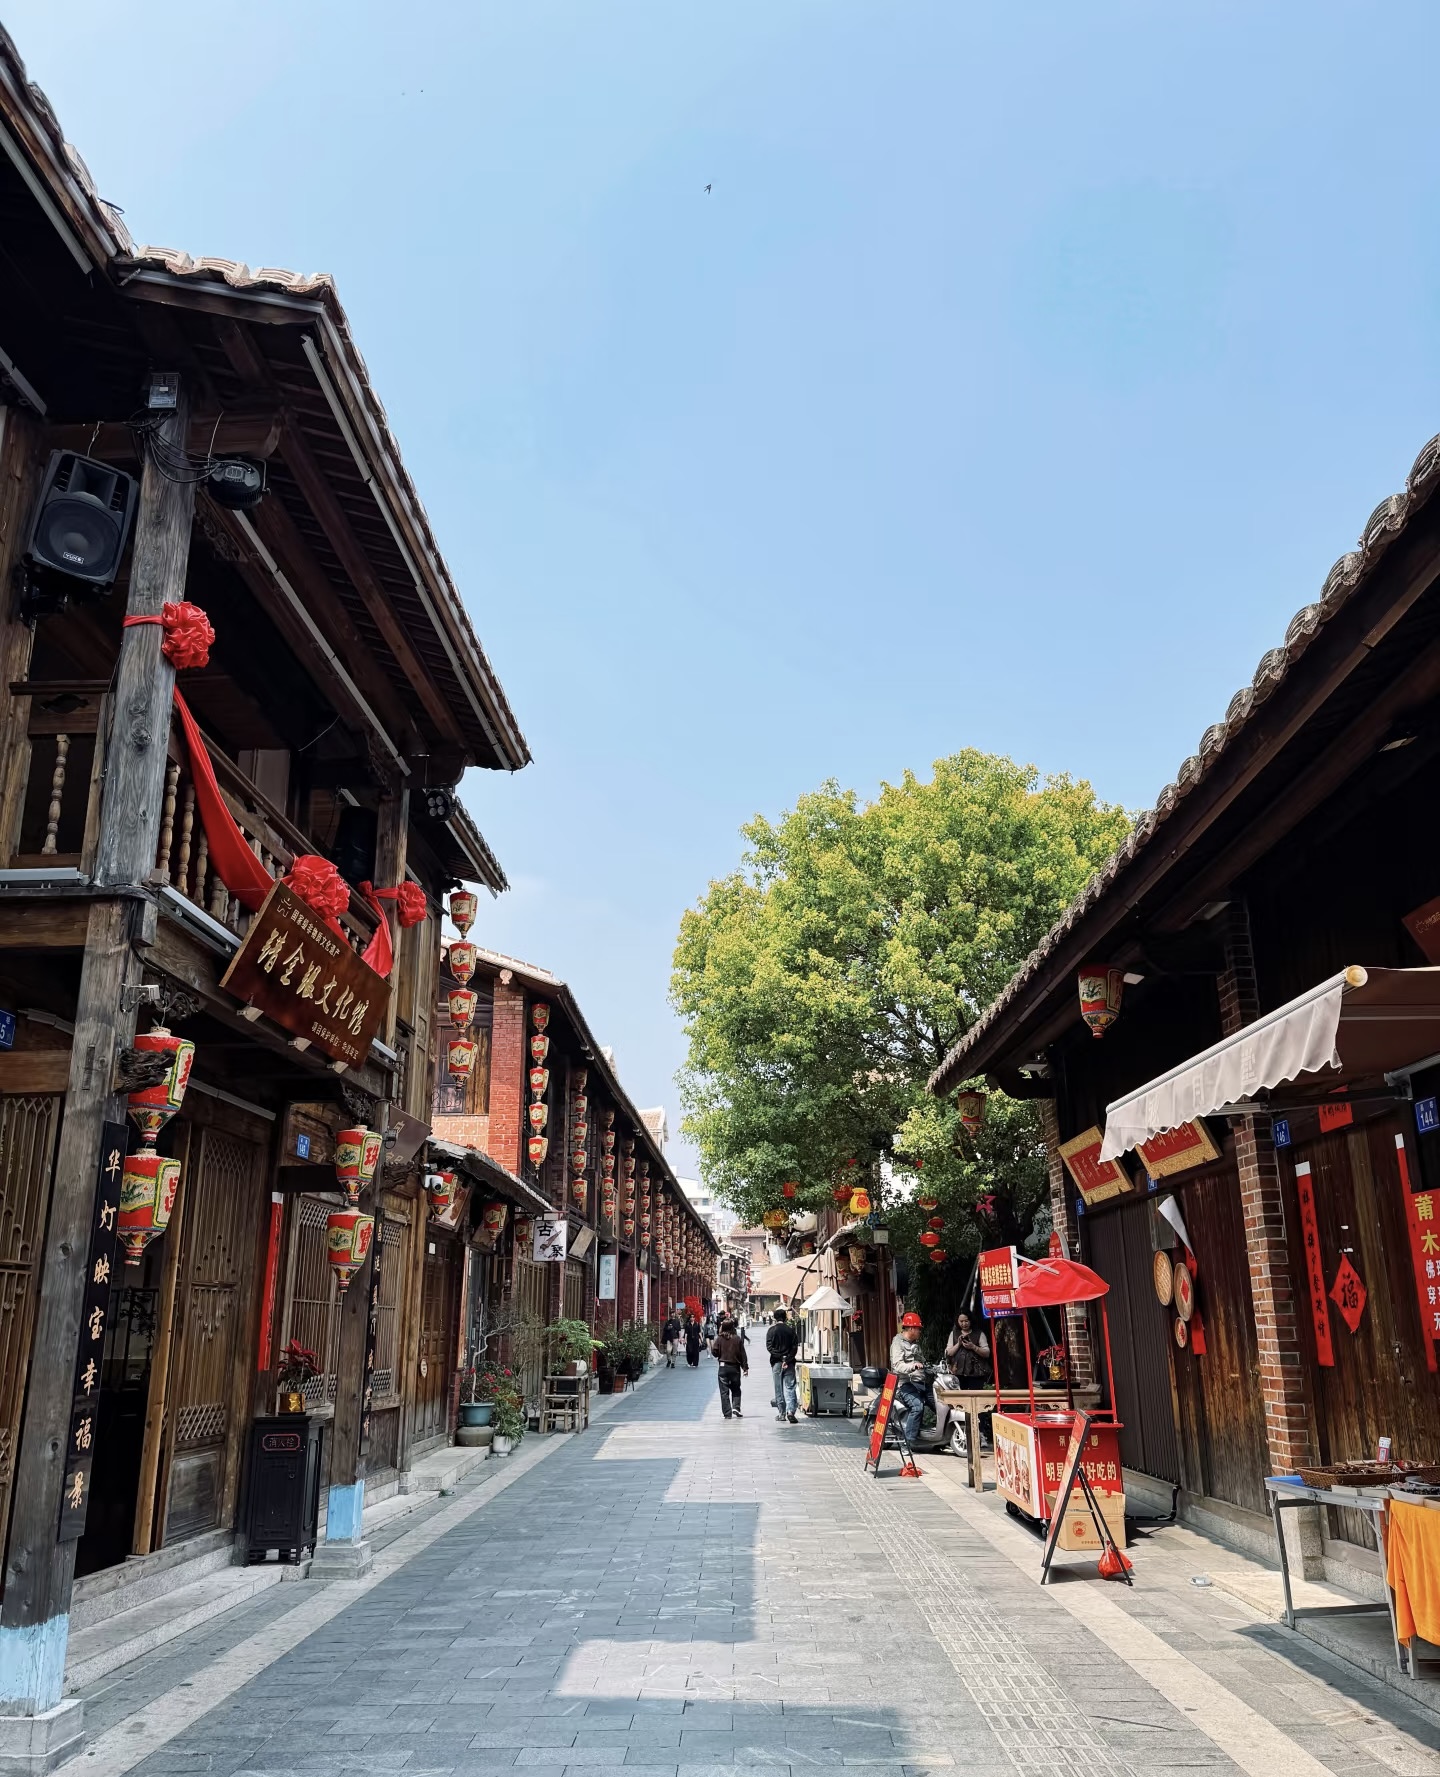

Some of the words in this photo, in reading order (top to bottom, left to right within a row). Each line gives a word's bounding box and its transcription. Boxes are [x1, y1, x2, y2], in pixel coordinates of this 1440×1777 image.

[289, 908, 341, 958] 国家级非物质文化遗产
[1420, 1110, 1434, 1127] 144
[536, 1222, 564, 1258] 古琴
[1341, 1273, 1359, 1309] 福
[1426, 1284, 1440, 1305] 穿
[67, 1148, 121, 1509] 华灯映宝幸福景
[268, 1436, 295, 1448] 消火栓
